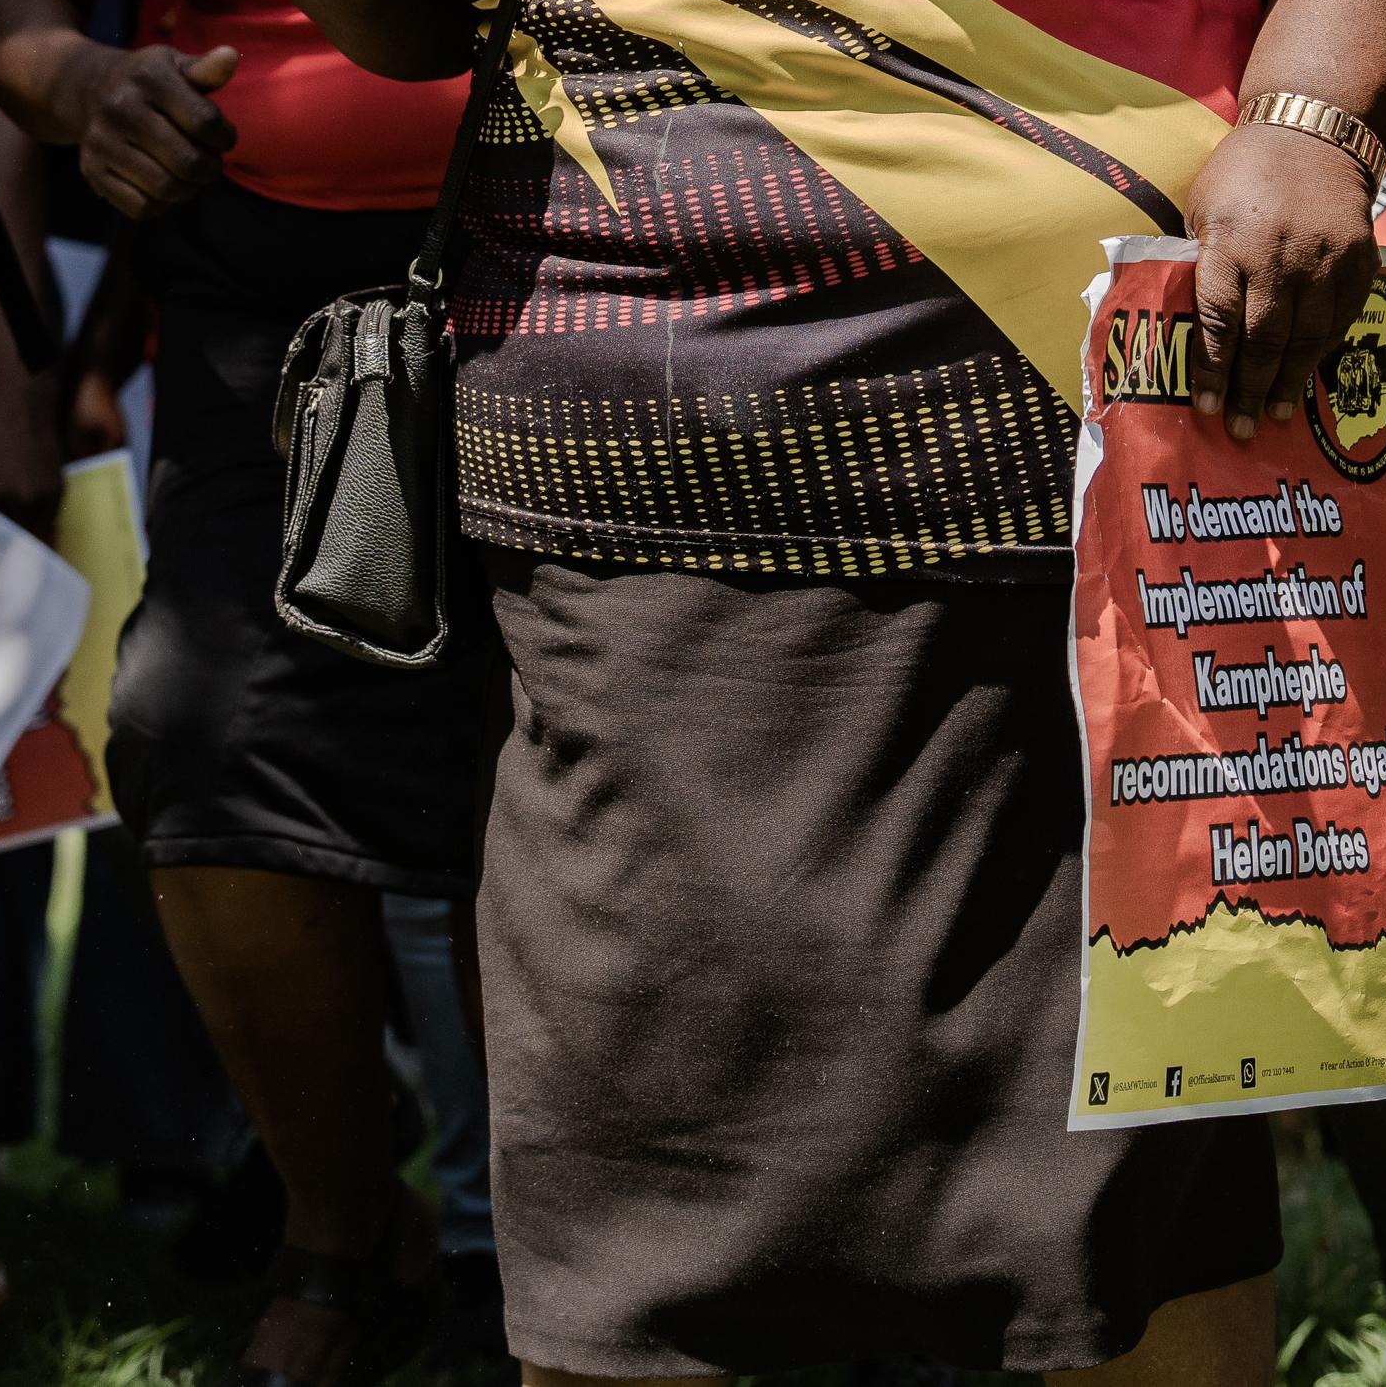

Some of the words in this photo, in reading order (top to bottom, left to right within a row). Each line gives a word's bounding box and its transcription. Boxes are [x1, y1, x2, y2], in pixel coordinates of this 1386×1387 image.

[1103, 314, 1193, 398] SAM
[1338, 459, 1347, 470] TO
[1347, 464, 1359, 476] ONE
[1143, 486, 1183, 542] We
[1190, 482, 1299, 537] demand
[1297, 484, 1341, 534] the
[1140, 566, 1341, 636] Implementation
[1342, 565, 1367, 616] of
[1192, 647, 1347, 716] Kamphephe
[1112, 735, 1348, 801] recommendations
[1212, 825, 1293, 883] Helen
[1298, 821, 1370, 872] Botes
[1113, 1079, 1158, 1094] @SAMWUnion
[1188, 1073, 1236, 1088] @OfficialSamwu
[1320, 1062, 1337, 1071] #Year
[1346, 1059, 1364, 1069] Action
